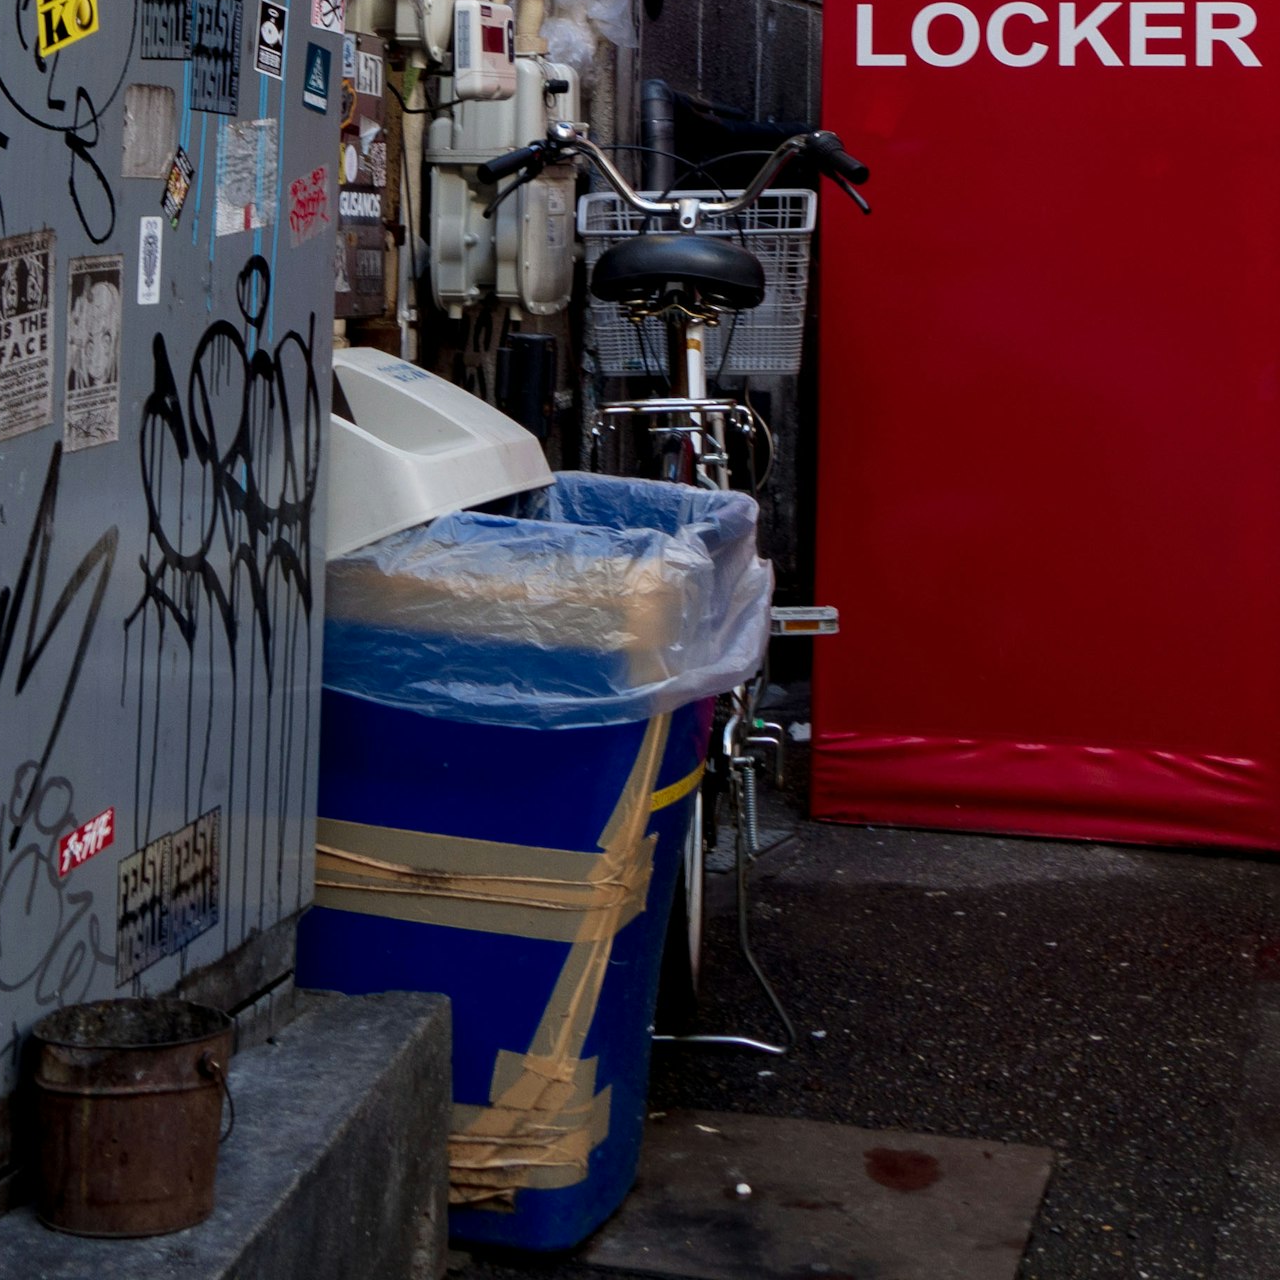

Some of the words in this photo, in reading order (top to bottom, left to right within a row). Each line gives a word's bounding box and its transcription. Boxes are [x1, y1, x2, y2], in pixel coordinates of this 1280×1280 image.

[856, 1, 1261, 68] LOCKER
[339, 191, 381, 218] GUSANOS
[0, 322, 12, 340] IS
[21, 312, 48, 335] THE
[0, 333, 48, 365] FACE
